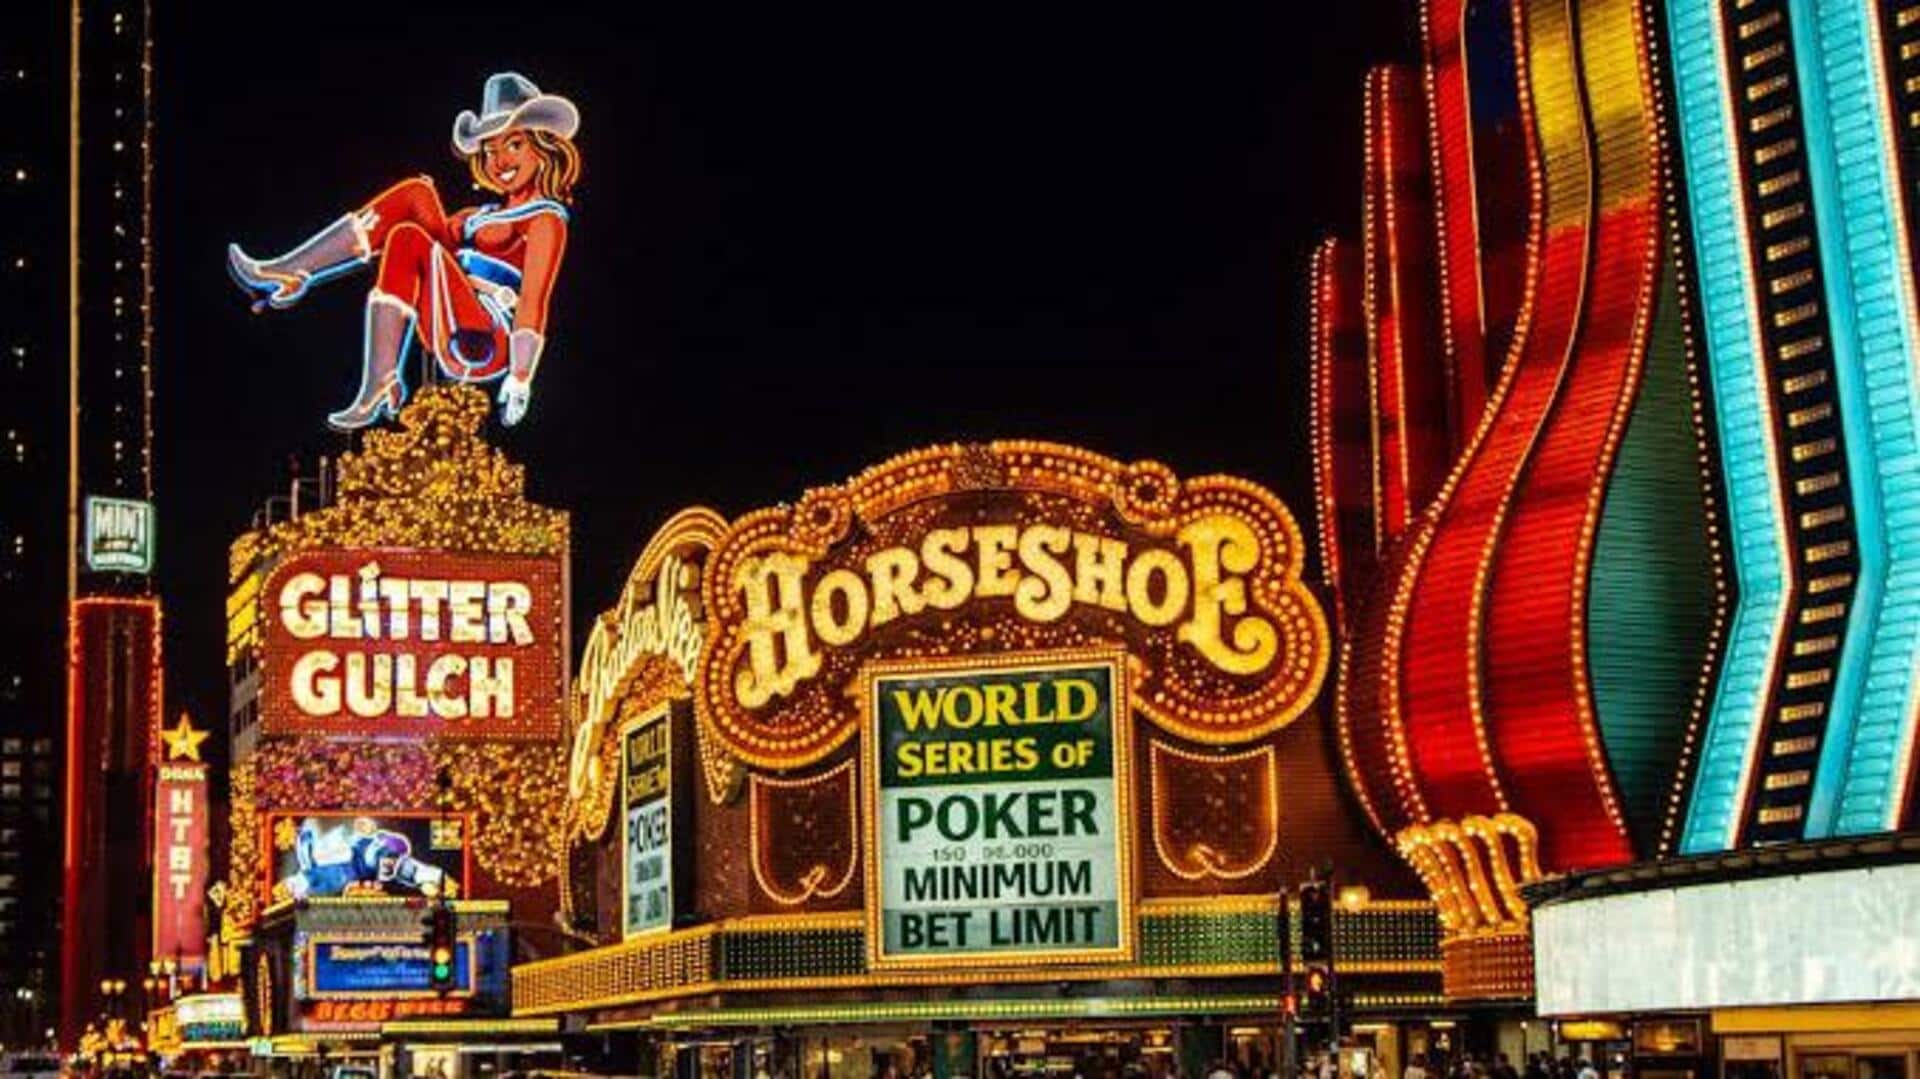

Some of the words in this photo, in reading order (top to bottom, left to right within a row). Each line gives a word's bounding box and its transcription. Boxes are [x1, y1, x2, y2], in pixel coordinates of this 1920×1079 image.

[94, 504, 145, 545] MINT
[734, 515, 1278, 710] HORSESHOE
[289, 650, 515, 720] GULCH
[894, 678, 1098, 733] WORLD
[896, 737, 1040, 779] SERIES
[1051, 739, 1096, 769] OF
[896, 788, 1099, 843] POKER
[903, 859, 1092, 902] MINIMUM
[899, 911, 972, 949] BET
[990, 905, 1101, 947] LIMIT
